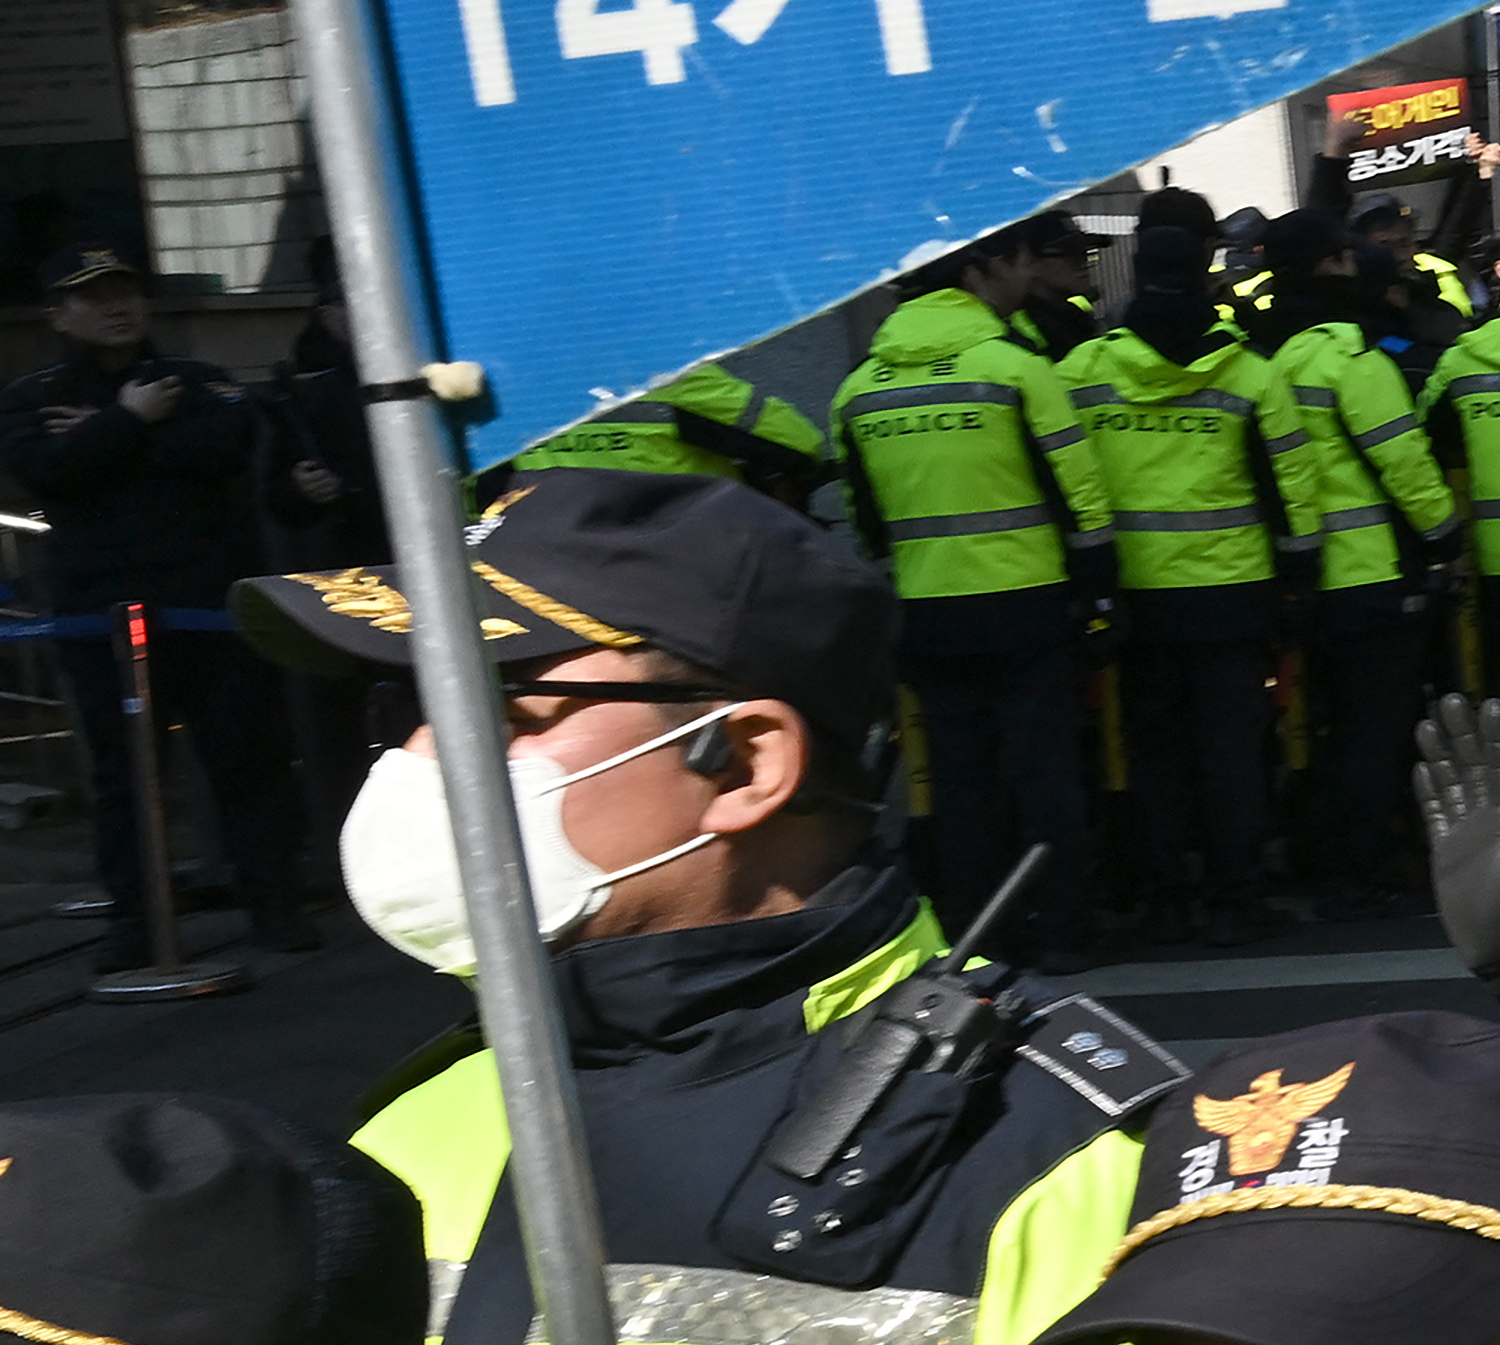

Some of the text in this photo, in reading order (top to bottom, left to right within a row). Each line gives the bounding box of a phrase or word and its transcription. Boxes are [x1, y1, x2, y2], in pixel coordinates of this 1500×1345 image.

[859, 409, 983, 441] POLICE
[1091, 411, 1223, 435] POLICE
[1179, 1117, 1349, 1189] 경찰
